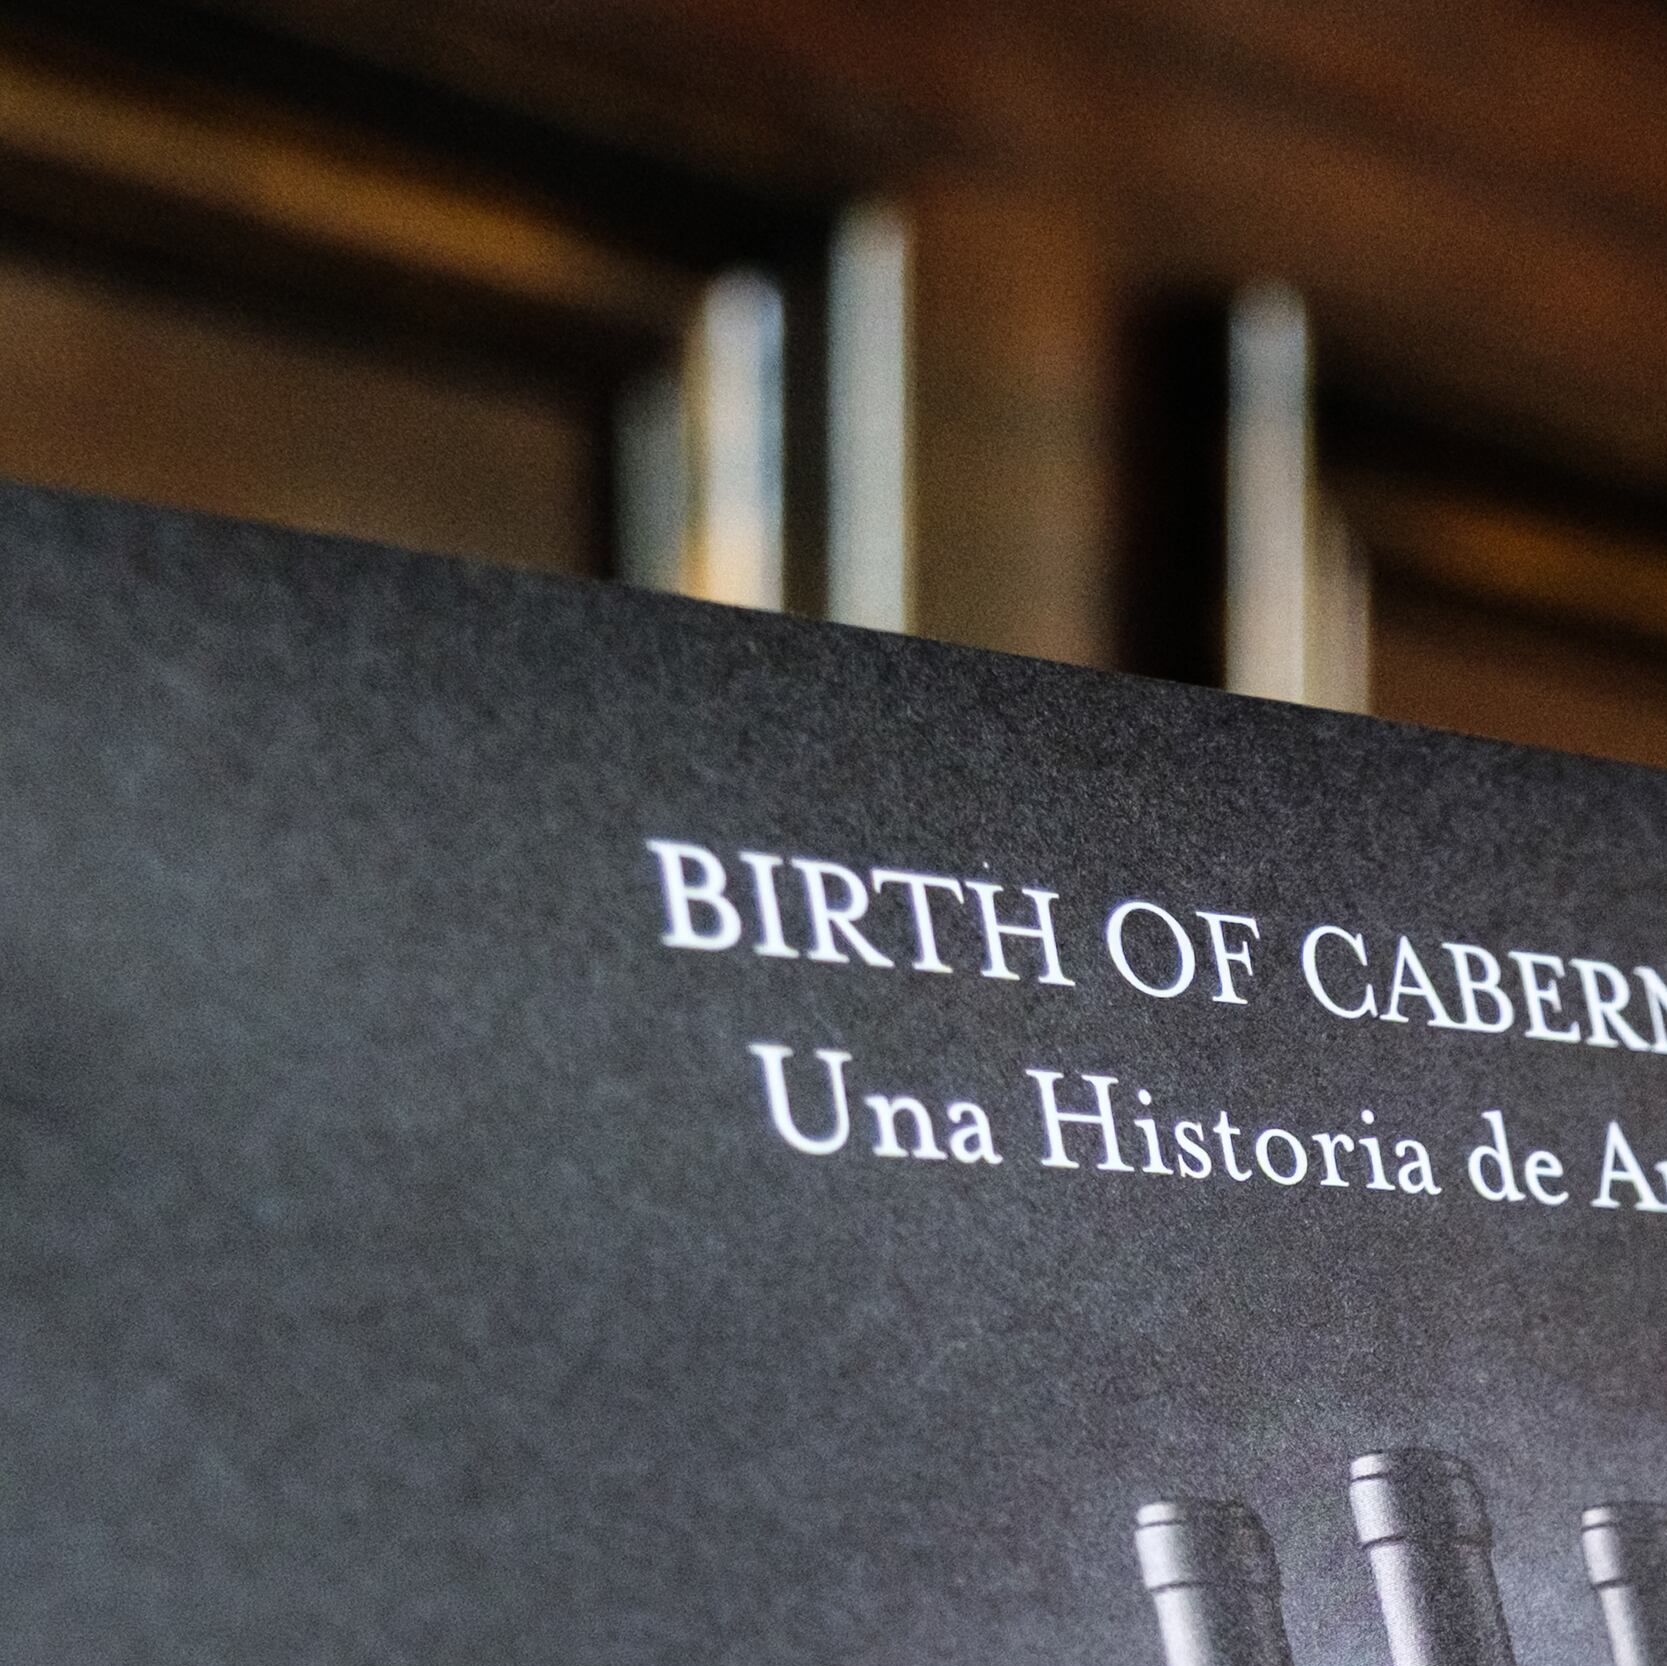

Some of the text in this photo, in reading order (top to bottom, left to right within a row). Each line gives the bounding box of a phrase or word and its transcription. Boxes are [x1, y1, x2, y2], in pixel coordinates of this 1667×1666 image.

[645, 838, 1077, 988] BIRTH
[1105, 899, 1262, 1006] OF
[747, 1040, 1004, 1167] Una
[1024, 1066, 1444, 1197] Historia
[1466, 1108, 1571, 1207] de
